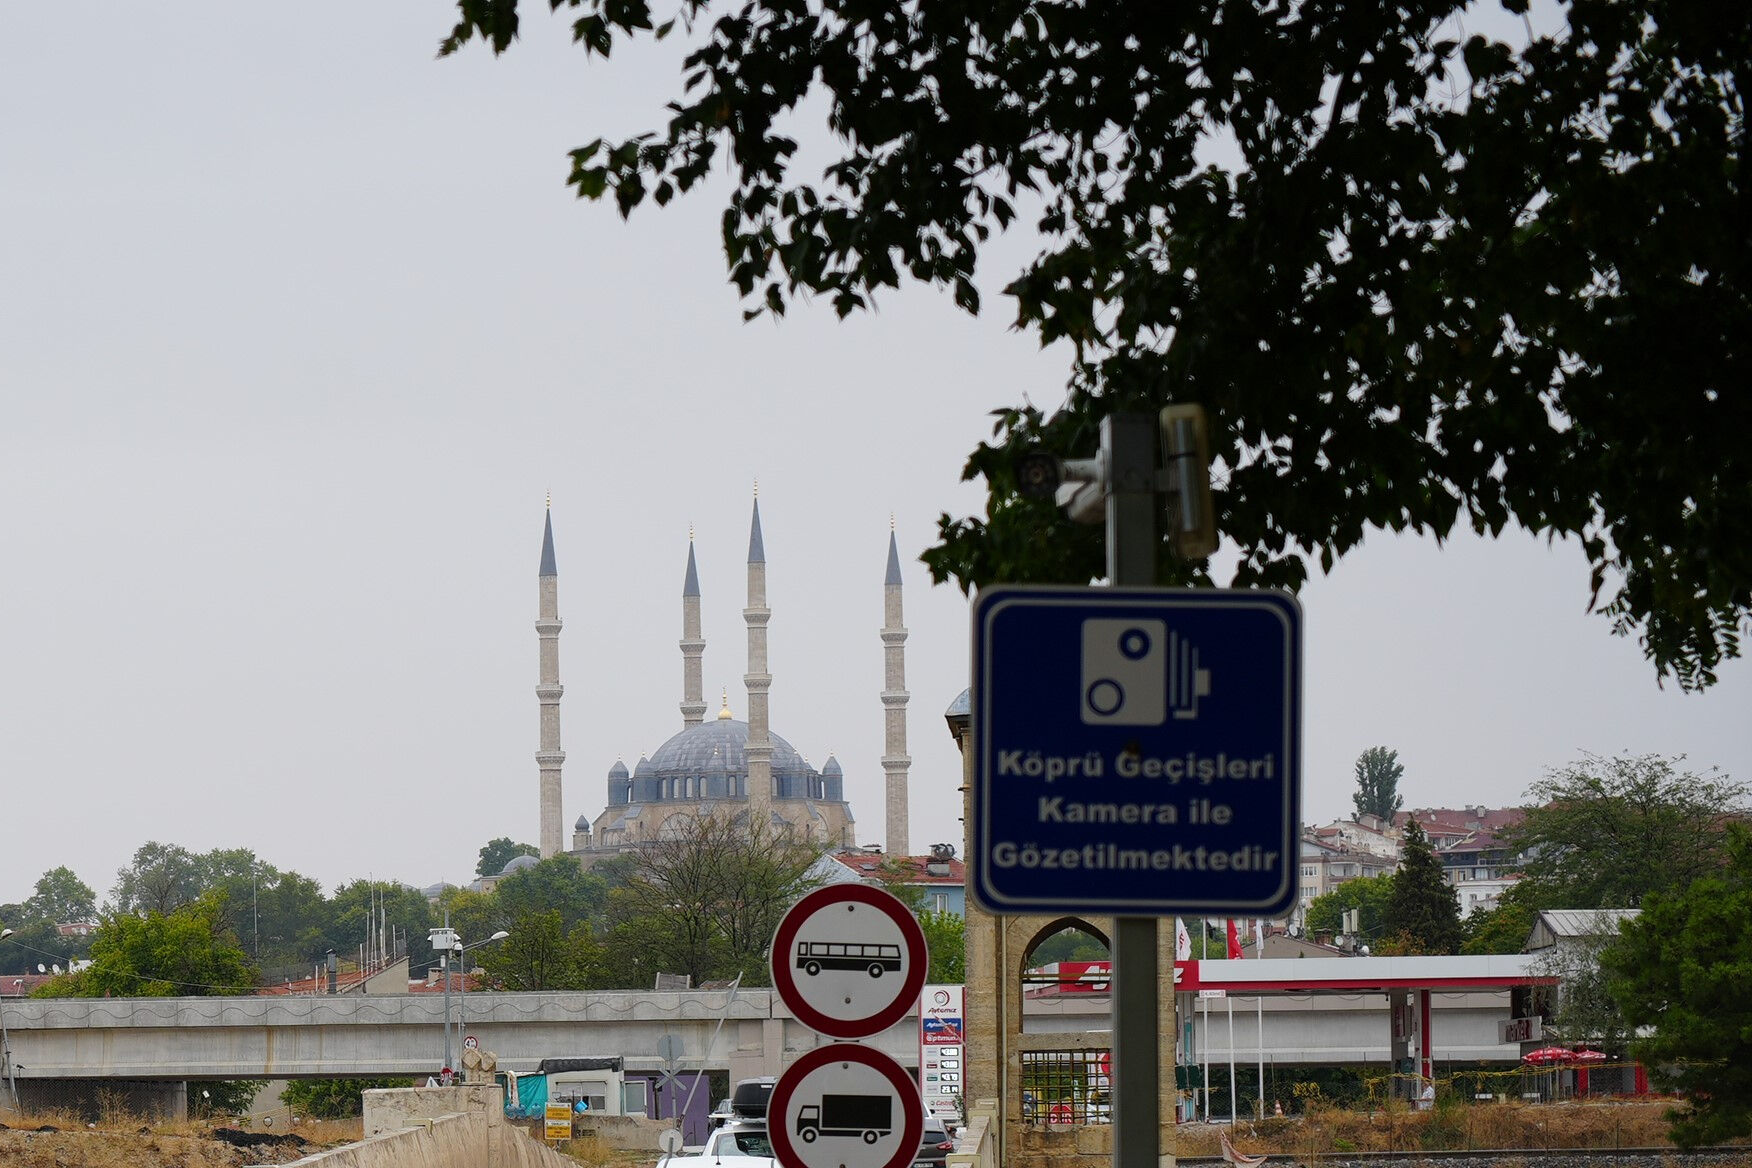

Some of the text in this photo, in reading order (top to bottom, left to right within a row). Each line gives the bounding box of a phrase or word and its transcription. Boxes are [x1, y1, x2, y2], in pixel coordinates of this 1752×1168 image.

[997, 750, 1275, 784] Köprü Geçişleri
[1038, 797, 1233, 825] Kamera ile
[992, 843, 1279, 872] Gözetilmektedir
